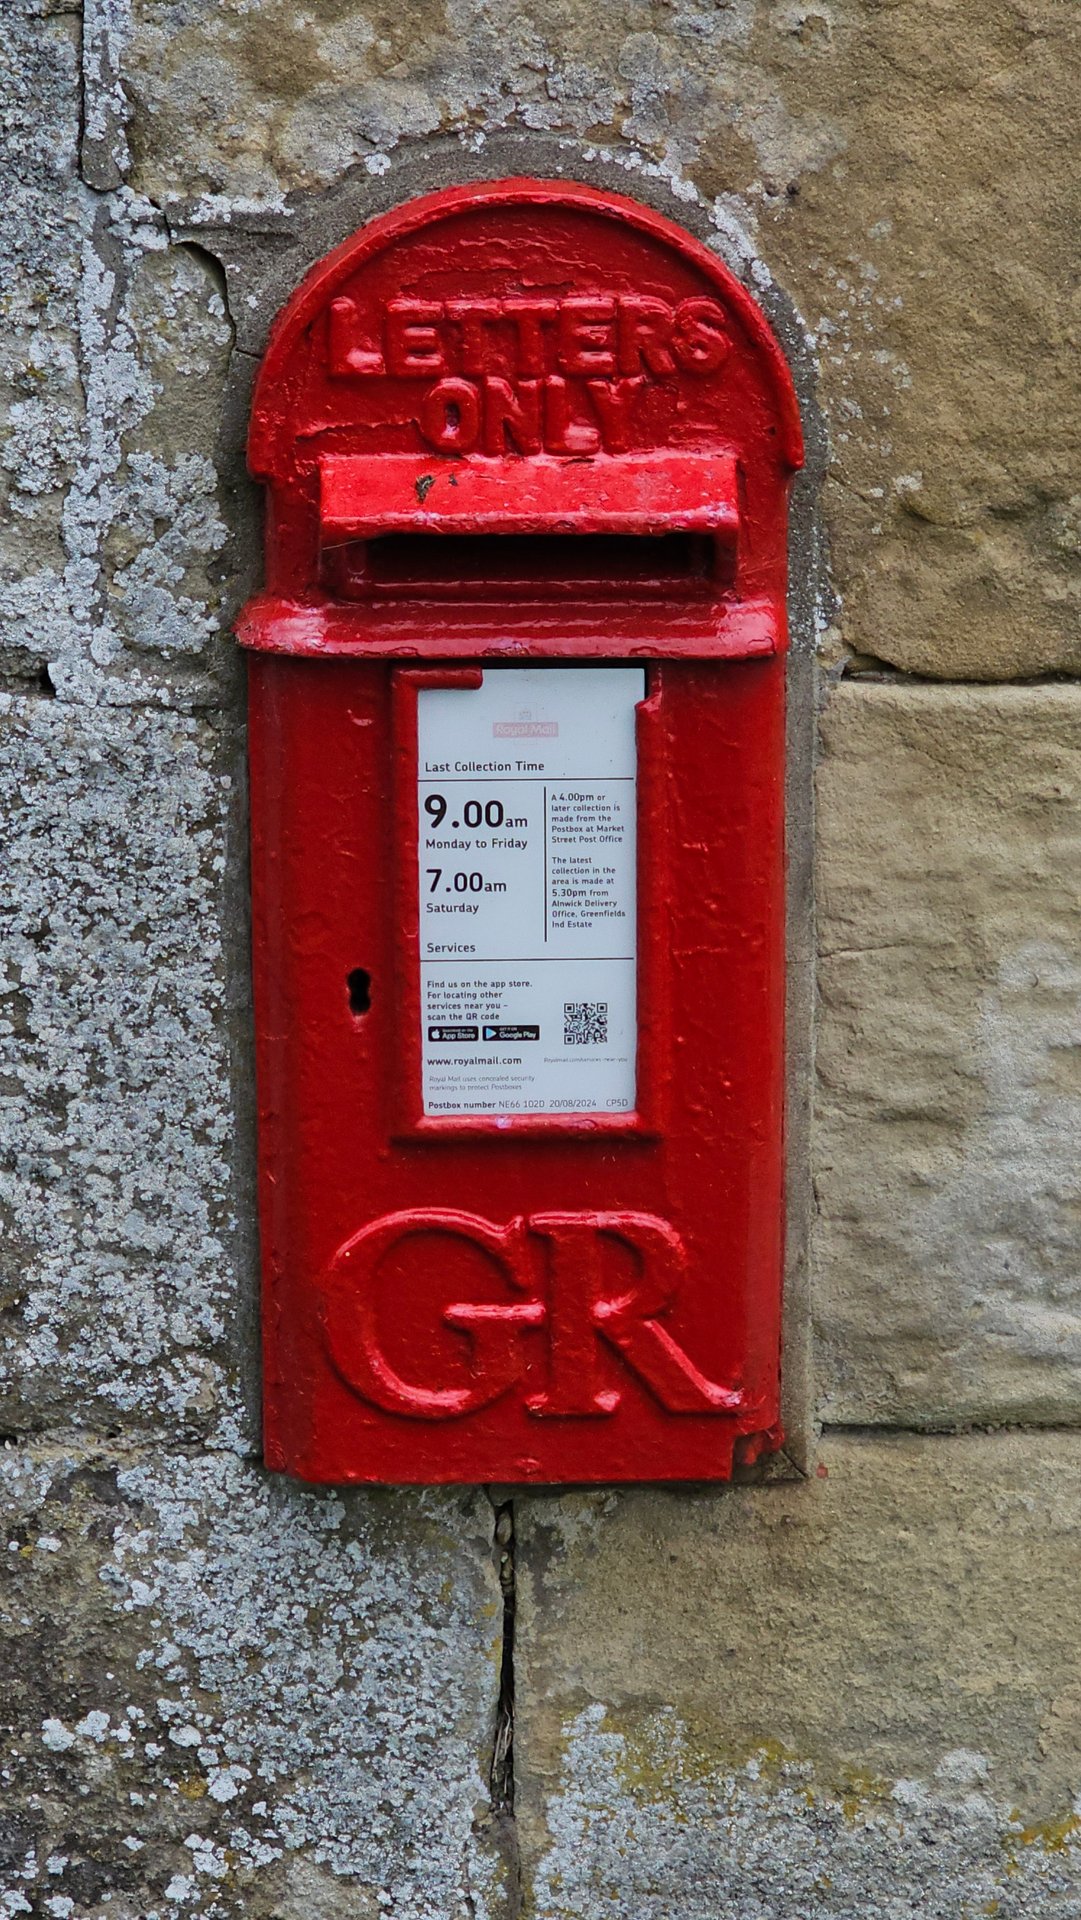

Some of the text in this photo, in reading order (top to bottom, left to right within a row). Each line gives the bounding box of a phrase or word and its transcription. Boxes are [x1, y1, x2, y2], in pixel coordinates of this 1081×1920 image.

[328, 295, 732, 378] LETTERS
[421, 374, 646, 456] ONLY
[496, 724, 555, 736] Royal Mail
[425, 760, 545, 772] Last Collection Time
[559, 793, 594, 803] 4.00pm
[424, 794, 528, 828] 9.00am
[551, 804, 570, 812] later
[613, 803, 621, 811] is
[551, 825, 583, 833] Postbox
[551, 835, 623, 843] Street Post Office
[425, 838, 528, 851] Monday to Friday
[551, 856, 592, 864] The latest
[426, 868, 507, 893] 7.00am
[572, 877, 579, 885] is
[551, 888, 587, 898] 5.30pm
[426, 902, 479, 915] Saturday
[585, 899, 617, 908] Delivery
[551, 910, 578, 918] Office,
[427, 942, 476, 953] Services
[427, 980, 445, 988] Find
[474, 980, 488, 988] the
[490, 981, 506, 990] app
[509, 980, 533, 988] store.
[427, 991, 441, 999] For
[443, 991, 477, 1000] locating
[427, 1002, 461, 1010] services
[485, 1003, 501, 1011] you
[442, 1032, 456, 1040] App
[499, 1031, 537, 1040] Google Play
[427, 1056, 522, 1067] www.royalmail.com
[511, 1074, 535, 1082] security
[468, 1084, 489, 1092] protect
[491, 1083, 522, 1091] Postboxes
[428, 1101, 461, 1109] Postbox
[463, 1101, 496, 1109] number
[498, 1100, 521, 1108] NE66
[549, 1099, 597, 1107] 20/08/2024
[322, 1206, 744, 1419] GR
